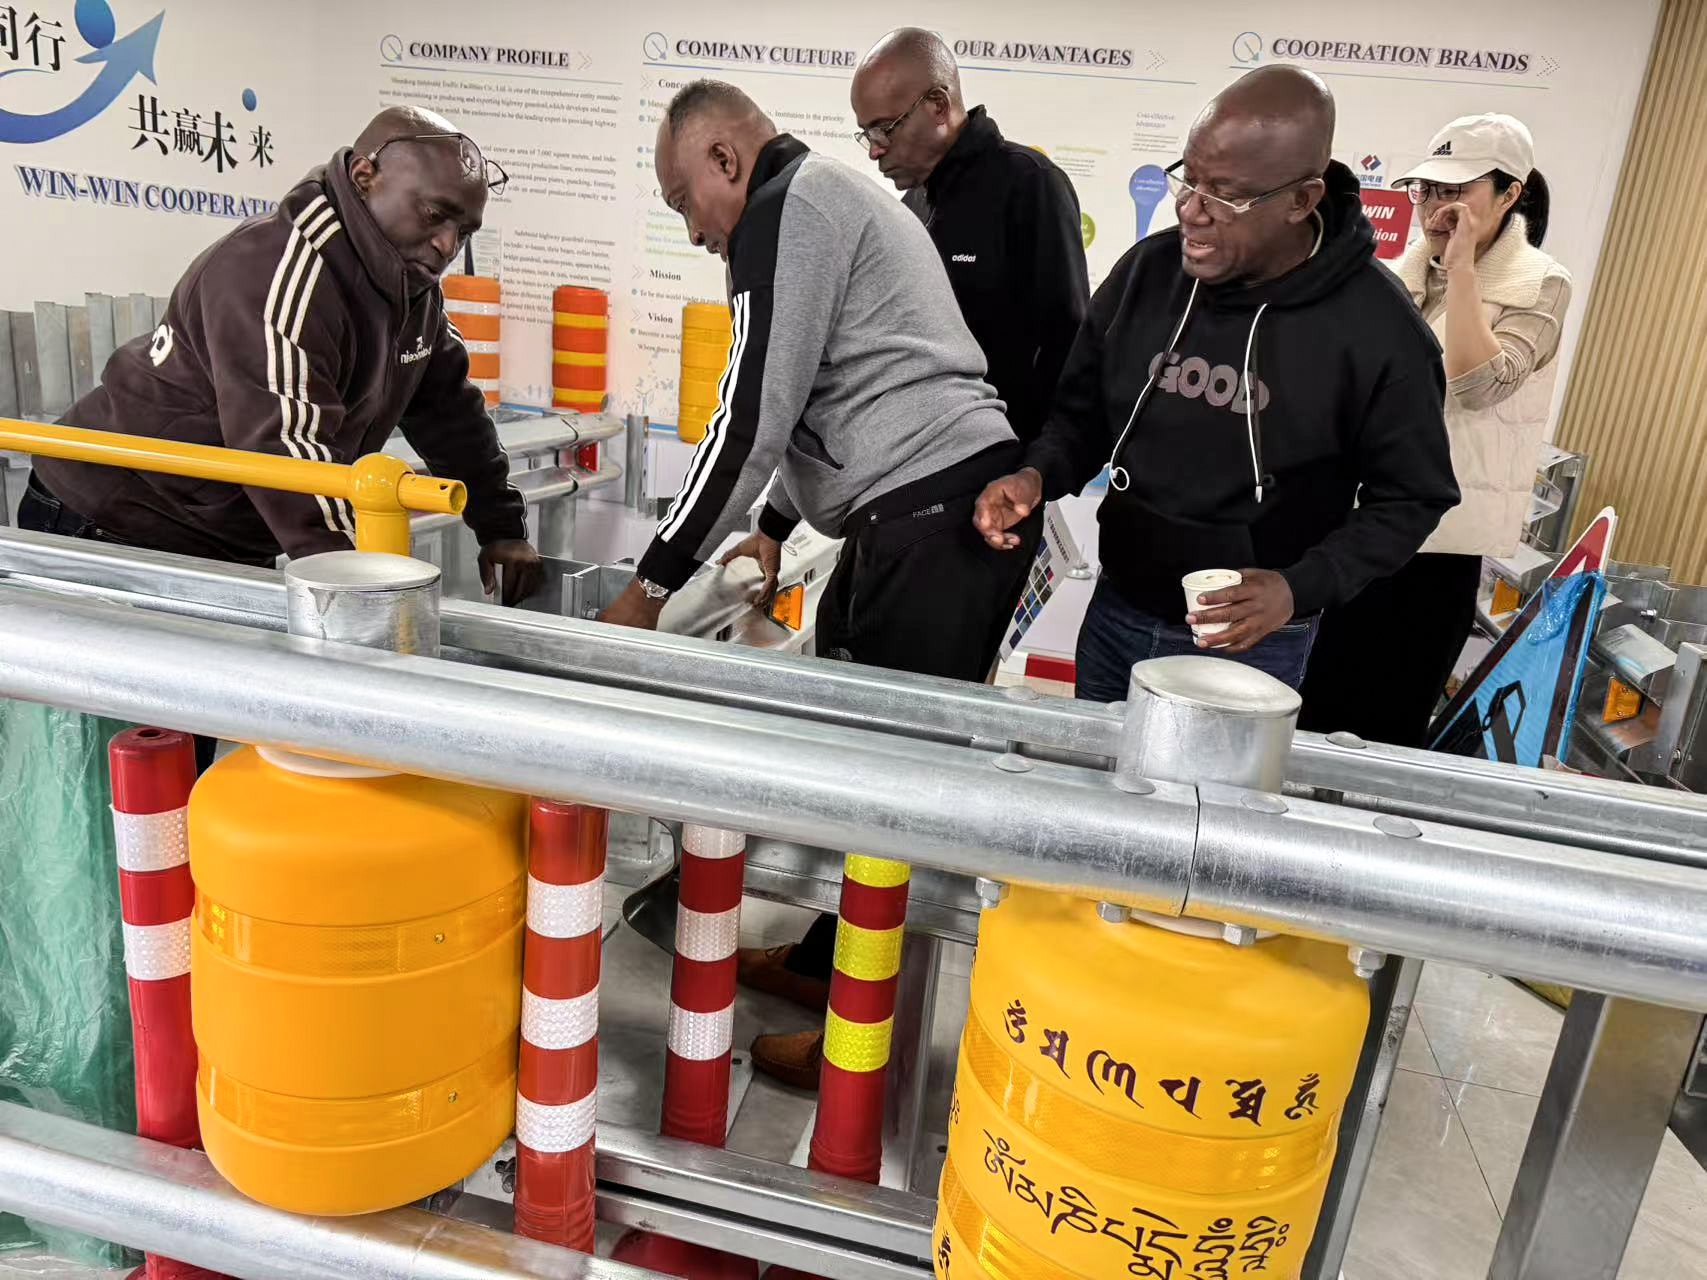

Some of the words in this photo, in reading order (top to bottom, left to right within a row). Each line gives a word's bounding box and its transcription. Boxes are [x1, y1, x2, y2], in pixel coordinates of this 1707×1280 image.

[409, 43, 491, 62] COMPANY
[496, 48, 570, 67] PROFILE
[676, 39, 768, 60] COMPANY
[769, 49, 857, 67] CULTURE
[954, 39, 995, 57] OUR
[999, 43, 1133, 67] ADVANTAGES
[1272, 38, 1432, 64] COOPERATION
[1438, 49, 1530, 72] BRANDS
[16, 165, 139, 206] WIN-WIN
[144, 184, 279, 217] COOPERATIO
[649, 268, 682, 281] Mission
[648, 312, 673, 324] Vision
